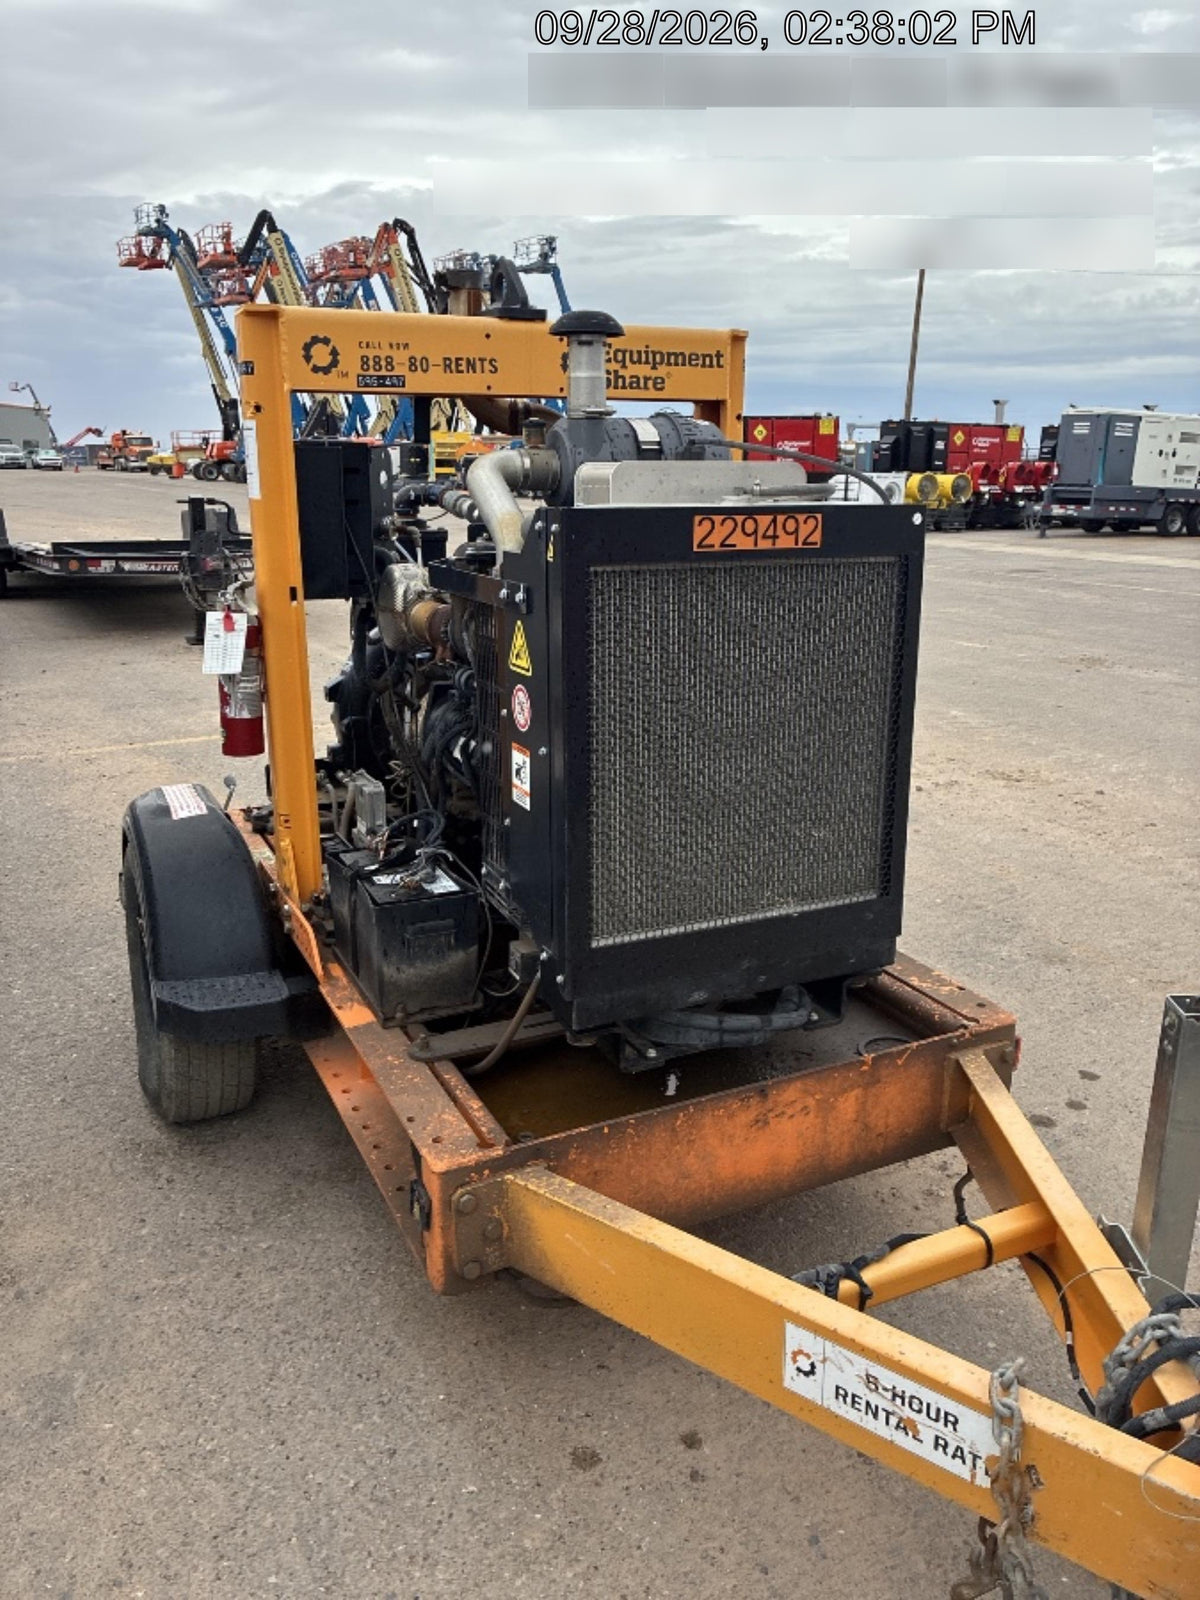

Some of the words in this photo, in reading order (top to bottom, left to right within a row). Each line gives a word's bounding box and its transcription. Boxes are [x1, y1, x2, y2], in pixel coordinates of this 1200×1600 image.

[360, 354, 499, 375] 888-80-RENTS
[695, 514, 820, 549] 229492
[933, 1434, 992, 1477] RAT
